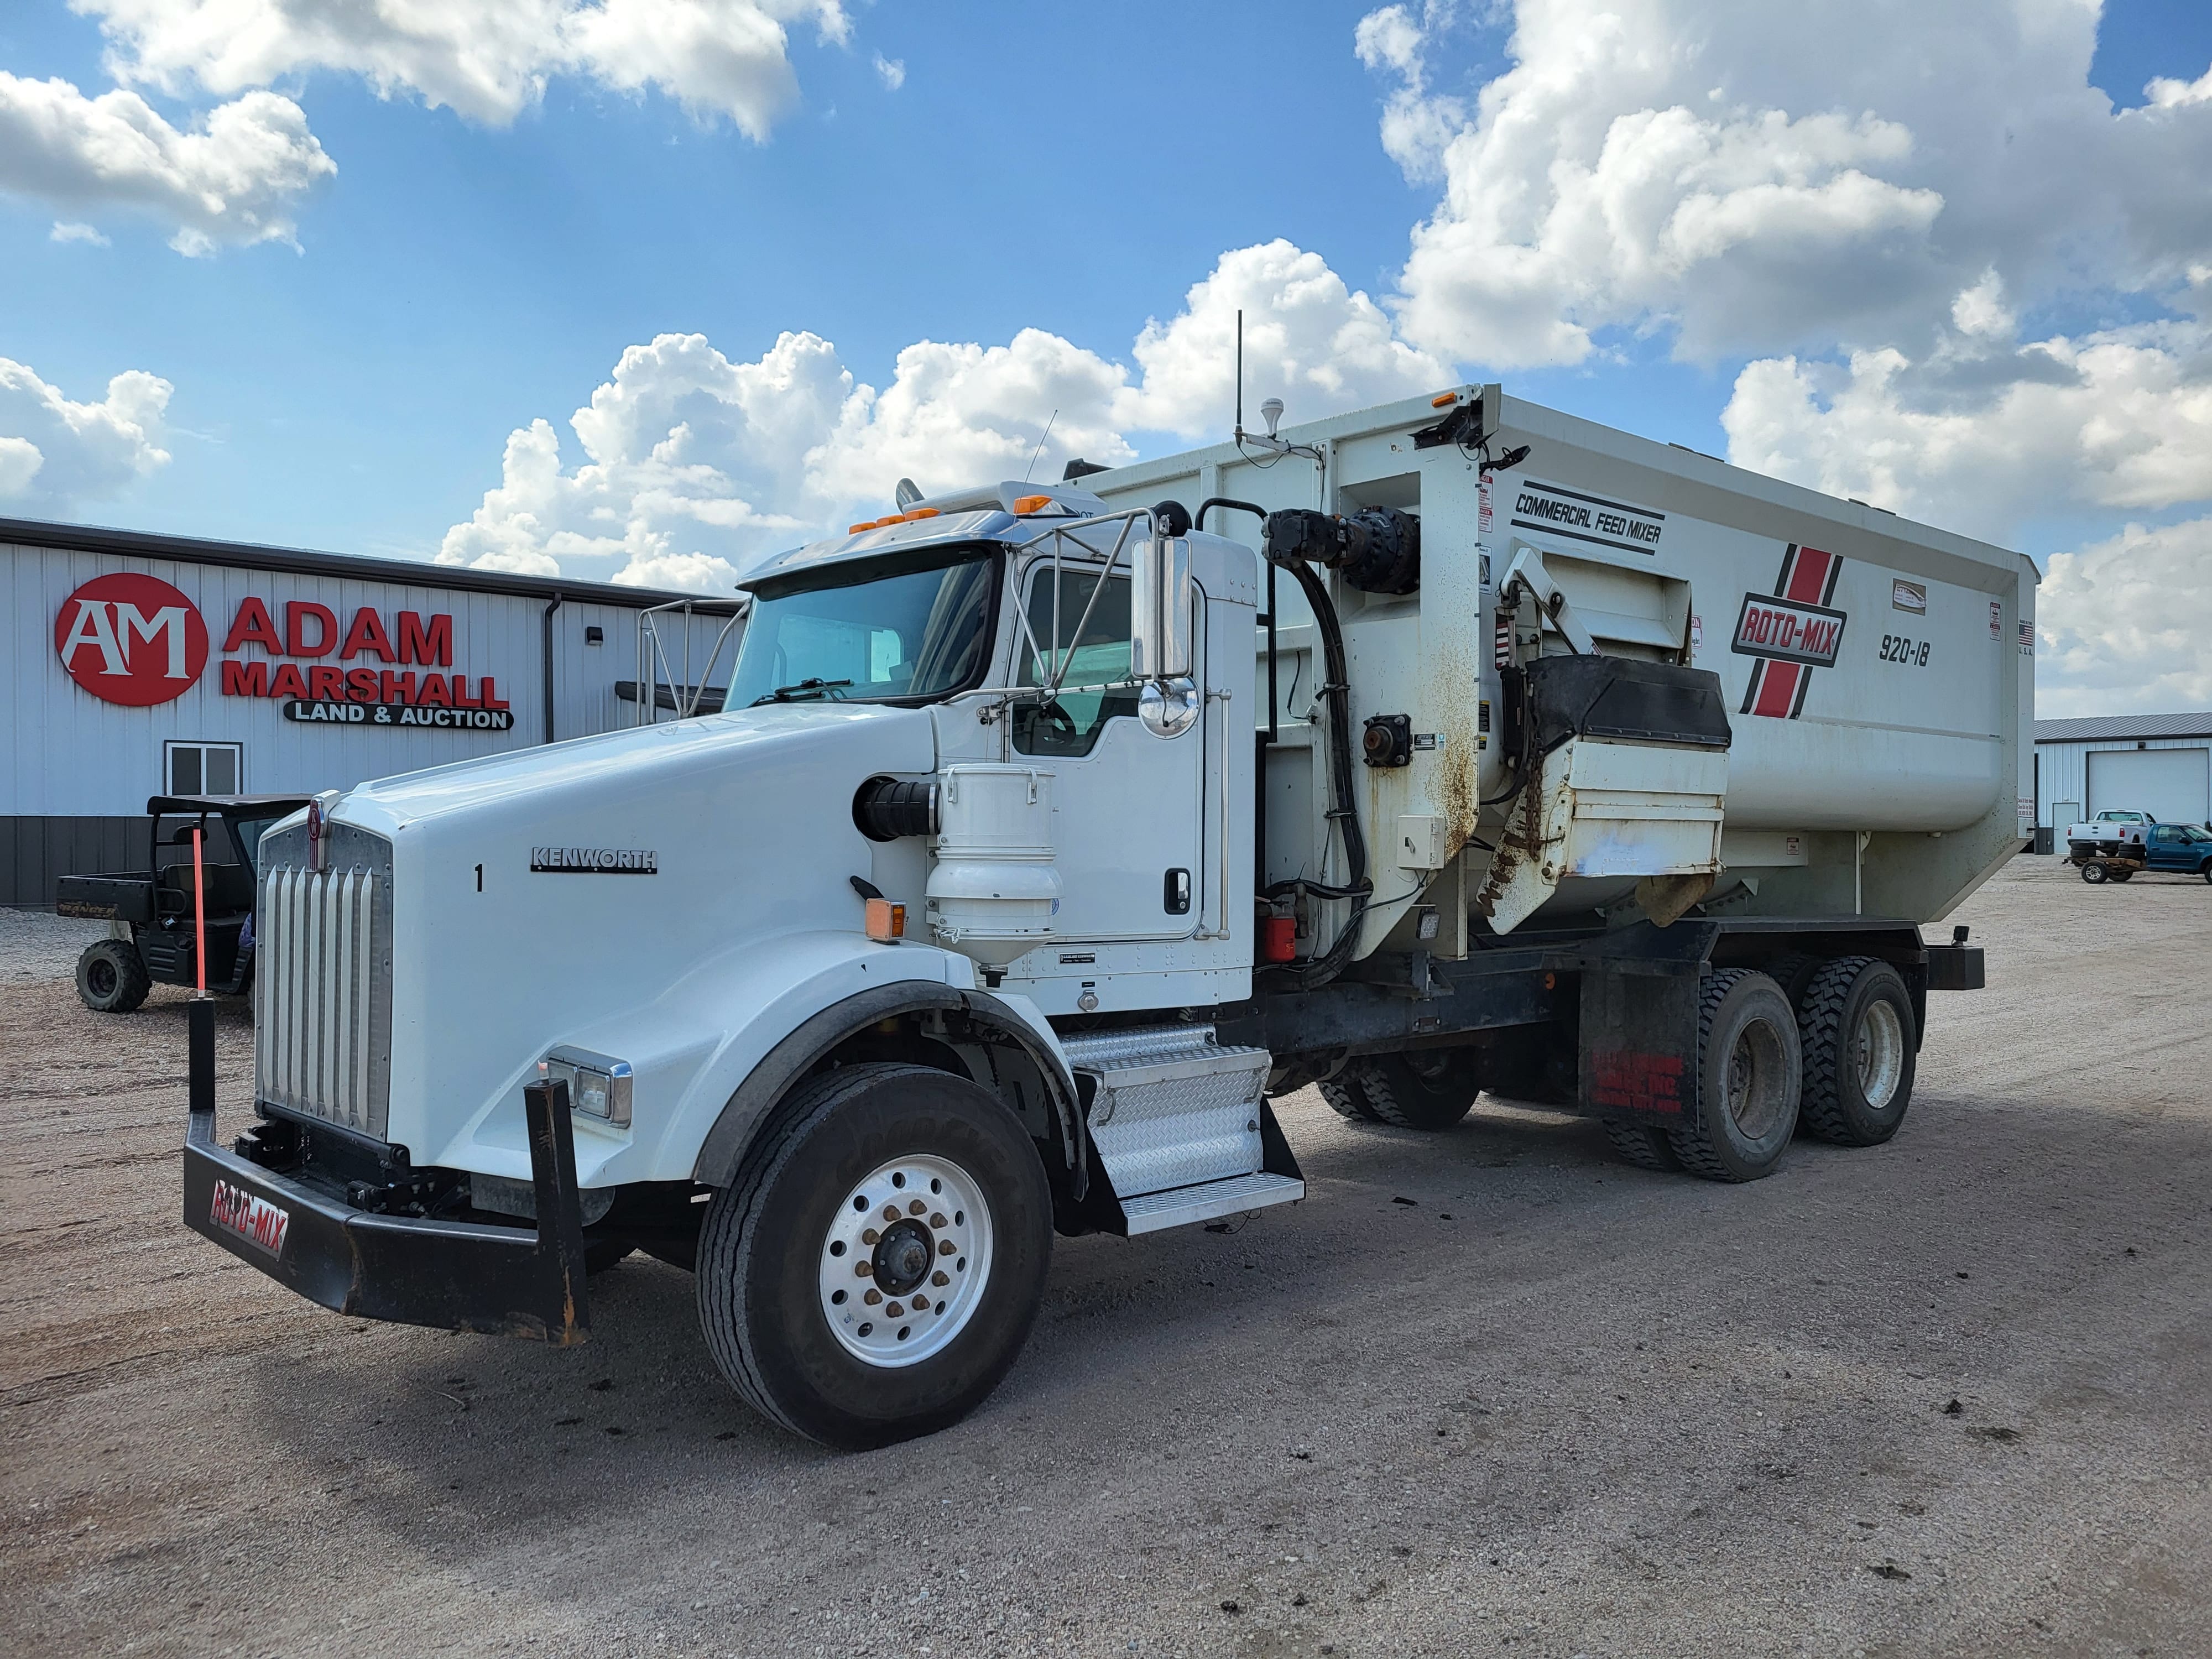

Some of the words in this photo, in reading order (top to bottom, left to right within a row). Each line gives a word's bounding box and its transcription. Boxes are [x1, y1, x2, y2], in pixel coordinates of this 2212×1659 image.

[1515, 493, 1592, 528] COMMERCIAL
[1595, 513, 1626, 536] FEED
[1626, 519, 1662, 545] MIXER
[61, 599, 190, 679] AM
[222, 597, 452, 666] ADAM
[1879, 634, 1931, 667] 920-18
[222, 660, 510, 709] MARSHALL
[295, 702, 365, 723] LAND
[374, 706, 392, 724] &
[399, 707, 507, 729] AUCTION
[533, 848, 657, 869] KENWORTH
[474, 864, 483, 892] 1
[61, 905, 116, 914] RANGER
